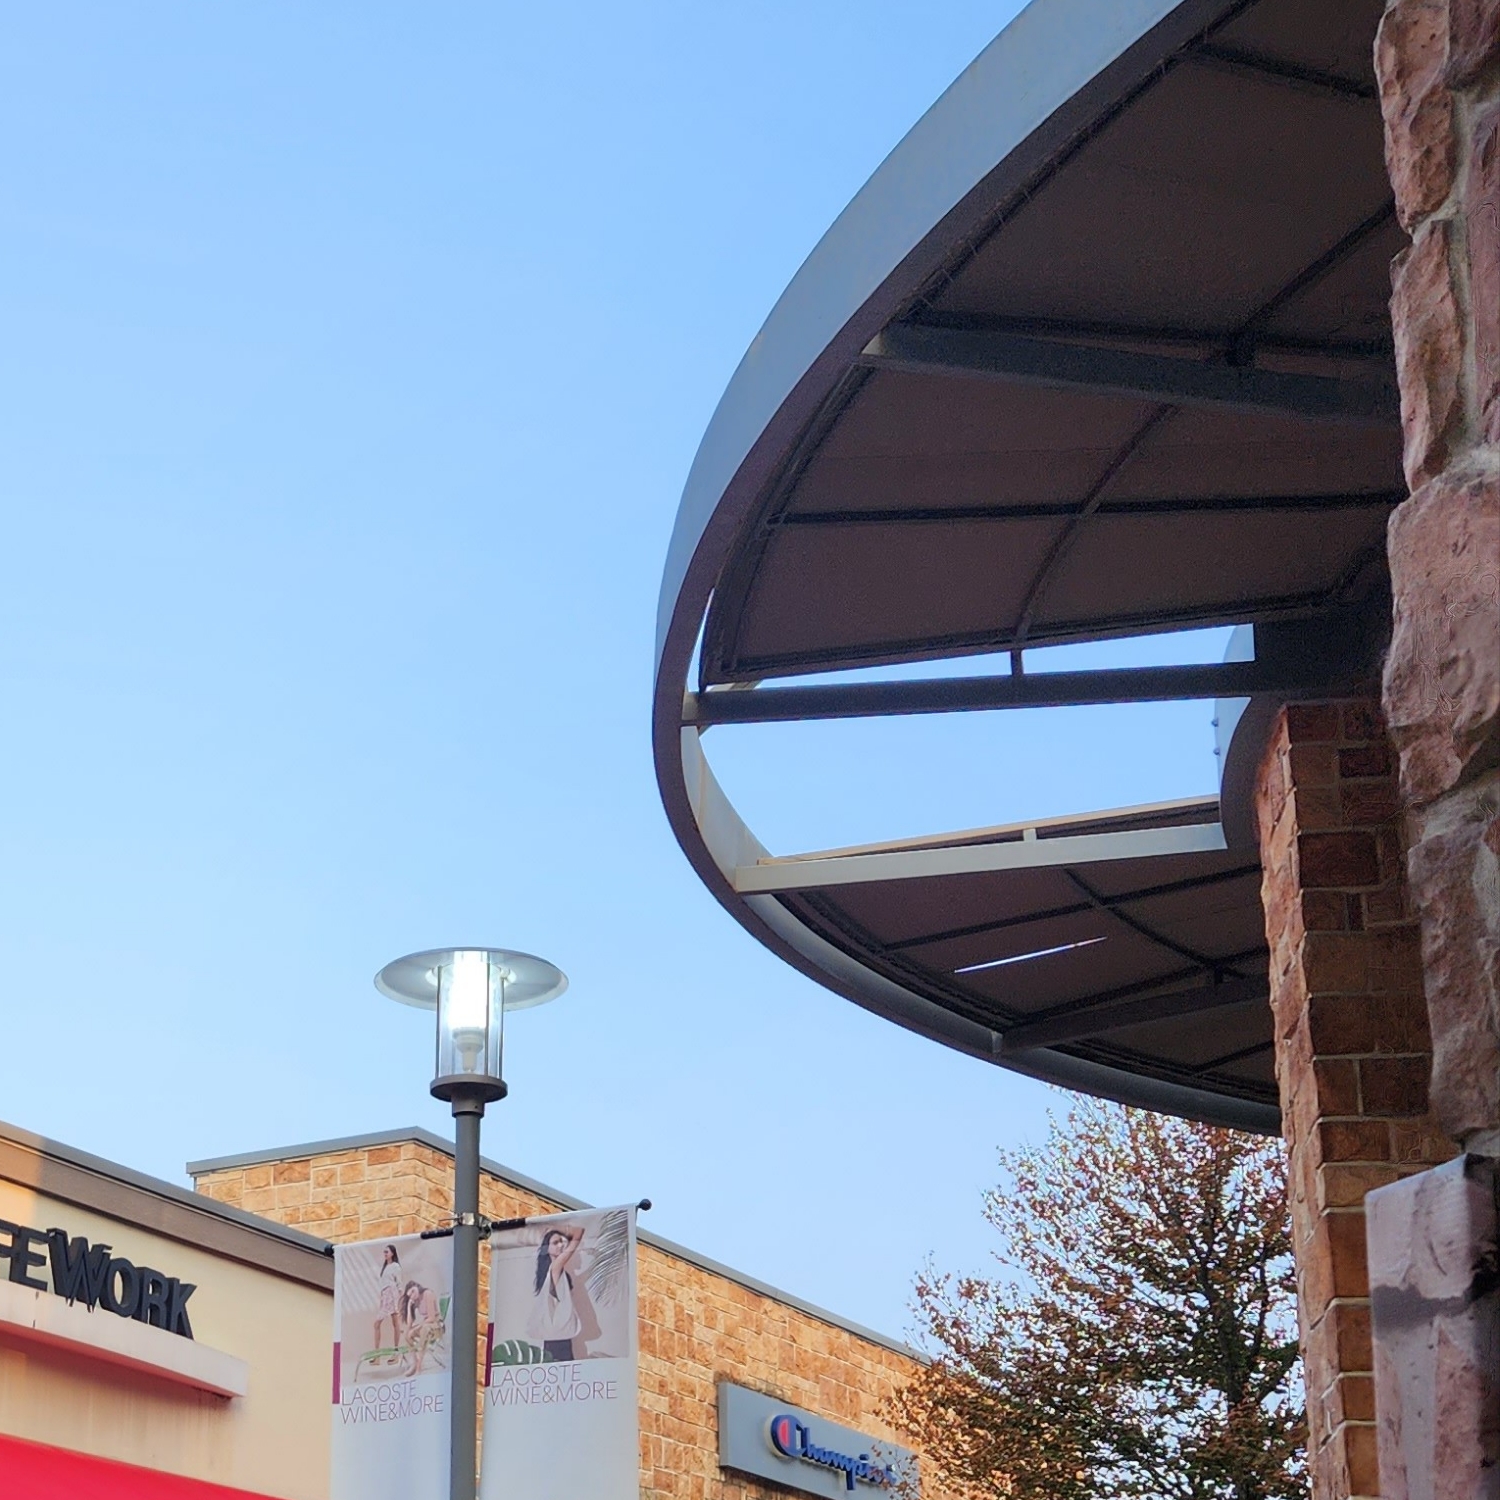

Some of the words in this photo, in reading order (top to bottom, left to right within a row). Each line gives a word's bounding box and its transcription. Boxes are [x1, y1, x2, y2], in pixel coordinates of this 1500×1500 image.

[490, 1362, 582, 1389] LACOSTE
[341, 1379, 417, 1407] LACOSTE
[490, 1380, 618, 1407] WINE&MORE
[340, 1393, 445, 1425] WINE&MORE
